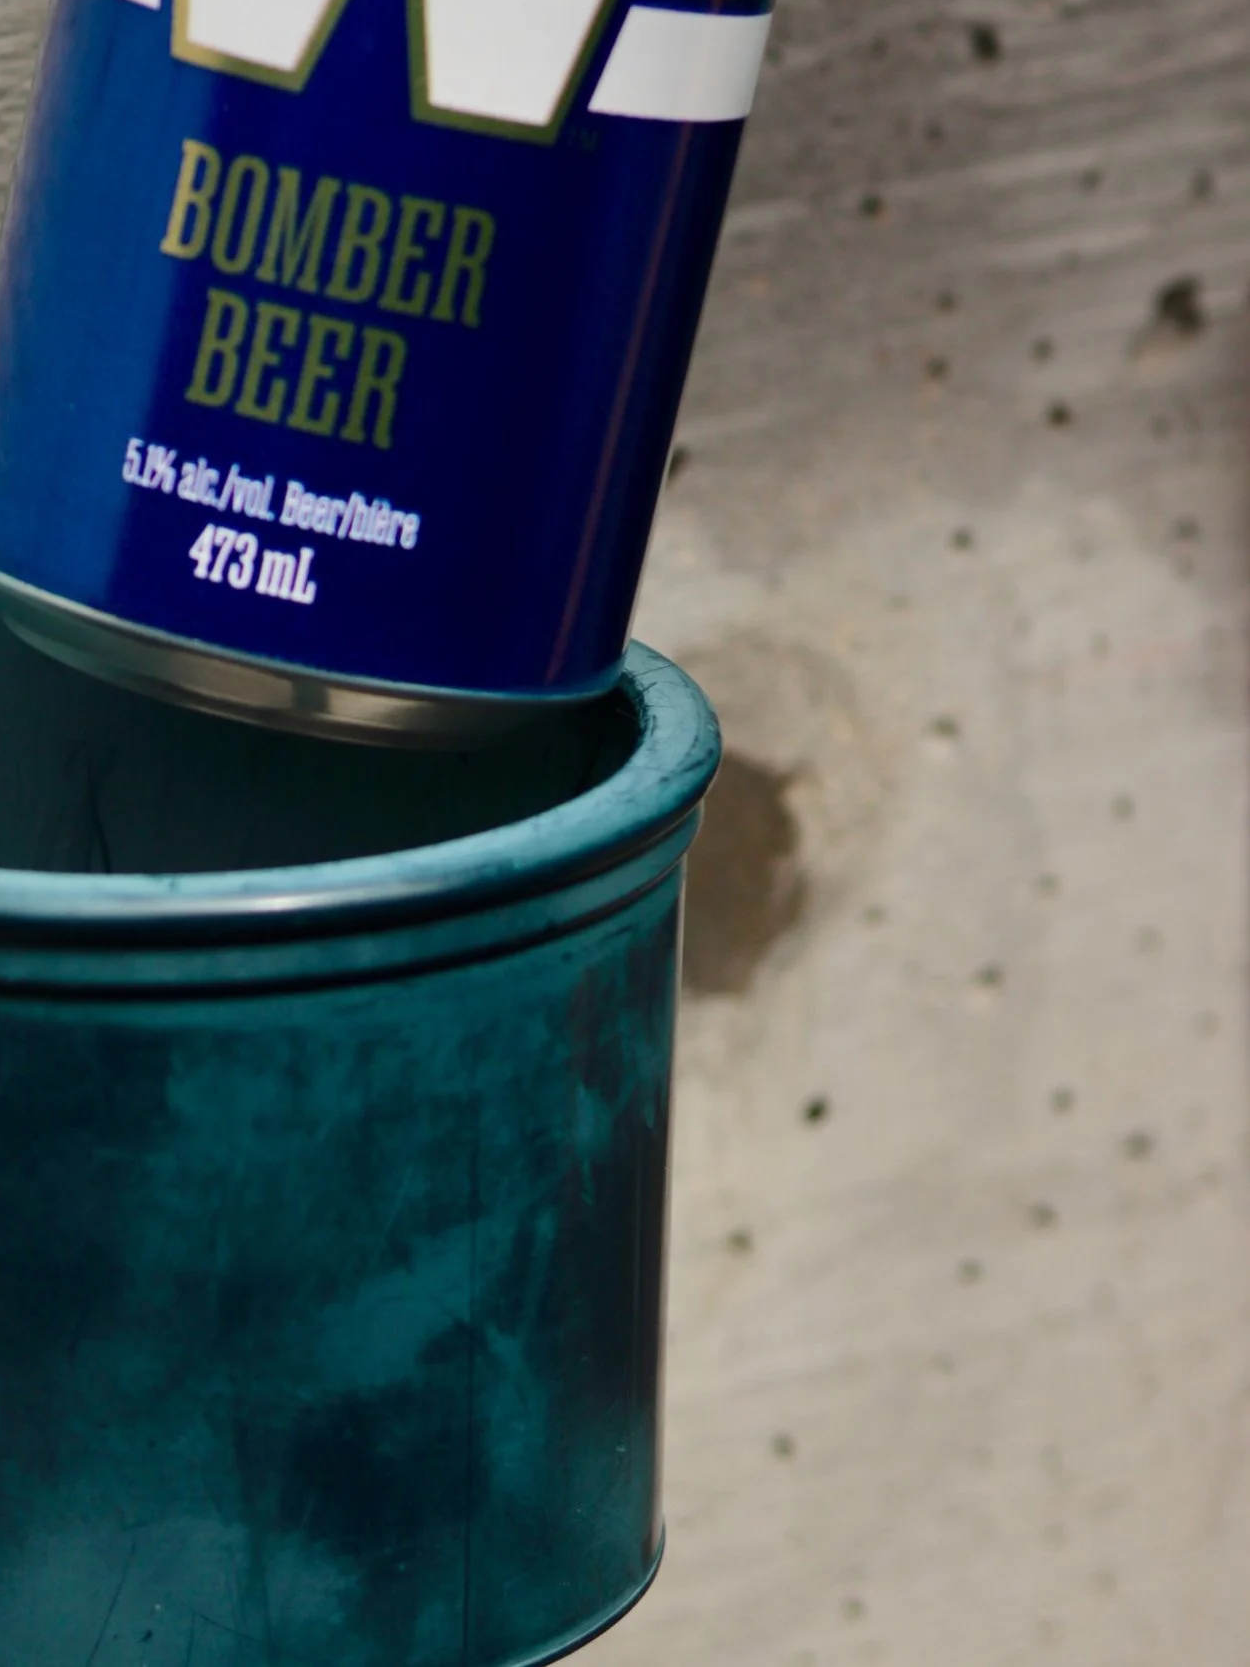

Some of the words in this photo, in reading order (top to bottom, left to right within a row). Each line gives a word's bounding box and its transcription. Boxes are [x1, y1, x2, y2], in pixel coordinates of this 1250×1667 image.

[159, 139, 496, 328] BOMBER
[185, 289, 407, 450] BEER
[122, 437, 177, 494] 5.1%
[189, 523, 258, 589] 473
[255, 547, 317, 605] mL
